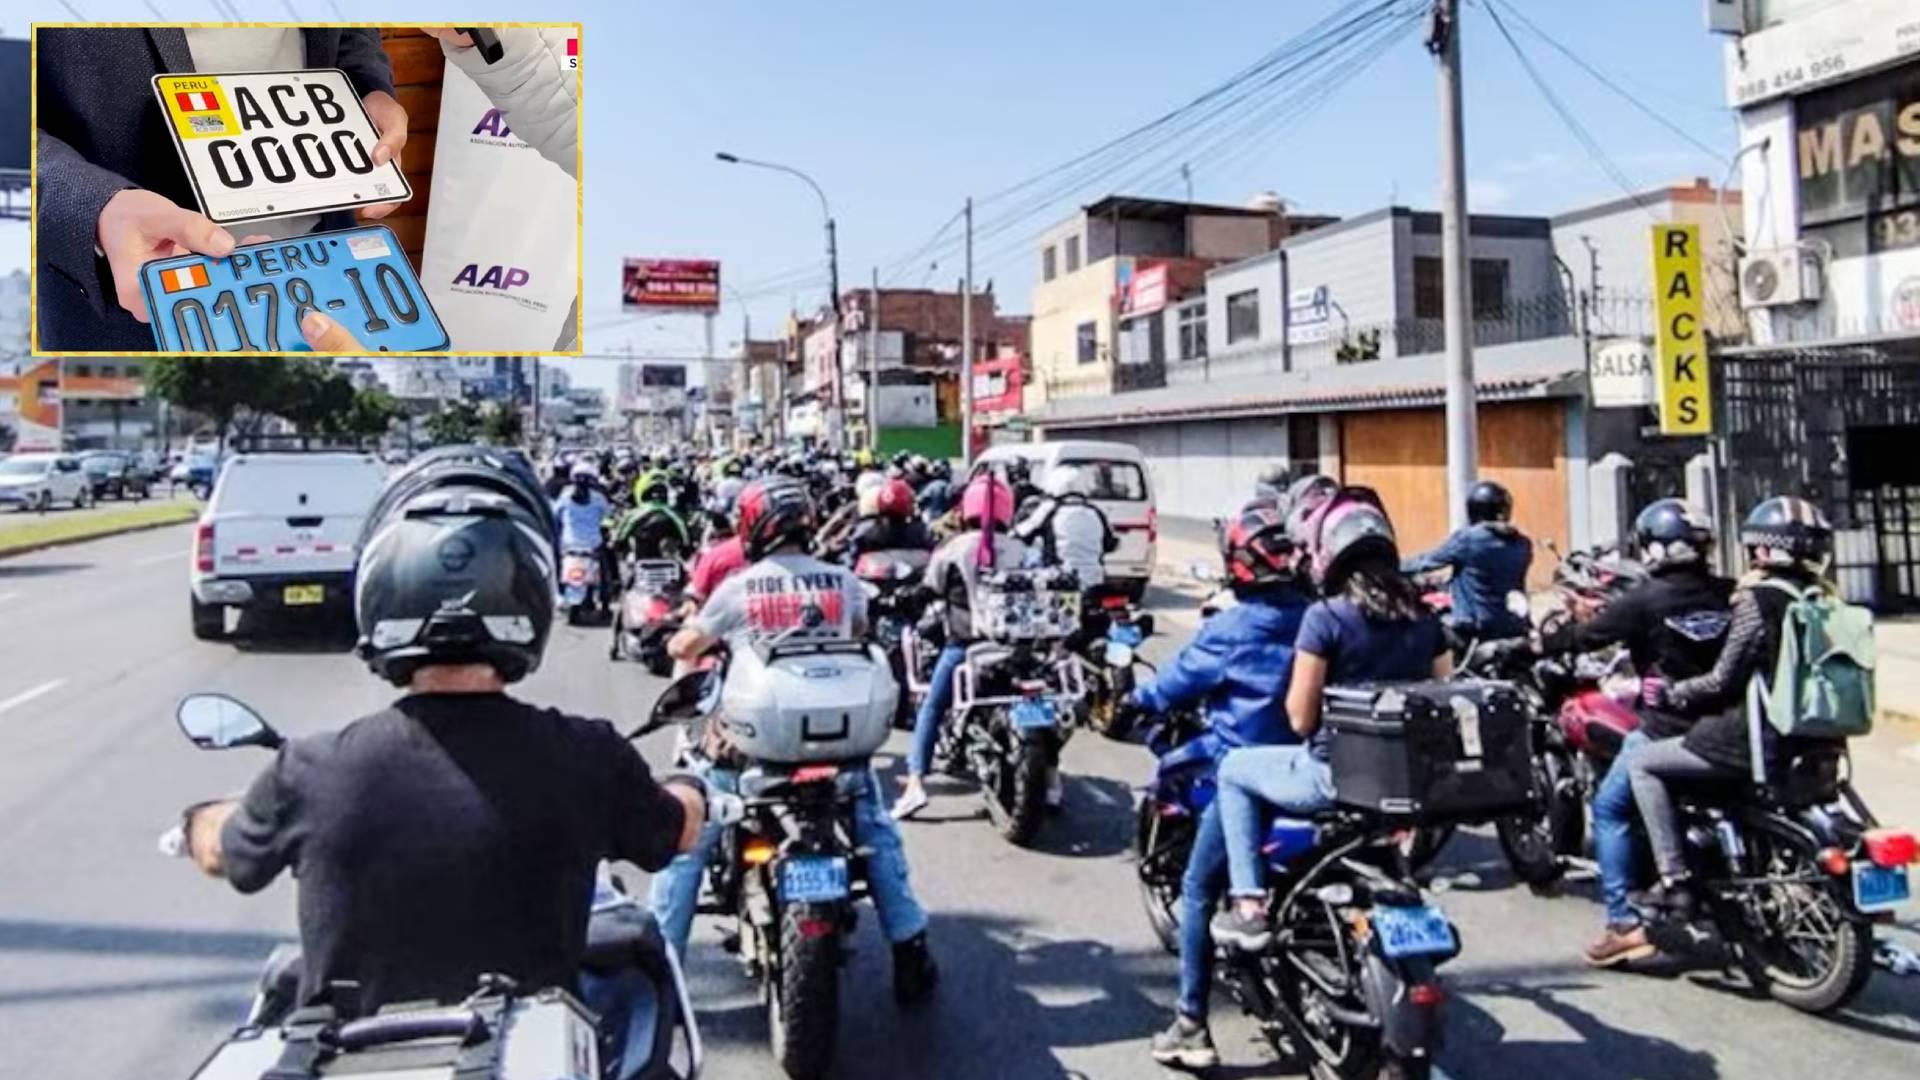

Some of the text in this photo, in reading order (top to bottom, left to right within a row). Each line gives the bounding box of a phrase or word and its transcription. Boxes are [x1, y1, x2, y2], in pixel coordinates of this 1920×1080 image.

[1810, 53, 1846, 77] 956
[173, 80, 208, 90] PERU
[235, 82, 346, 132] ACB
[208, 130, 376, 190] 0000
[229, 240, 331, 281] PERU
[452, 264, 529, 290] AAP
[1665, 229, 1699, 425] RACKS
[1592, 352, 1653, 377] SALSA
[746, 573, 843, 593] RIDE EVERY
